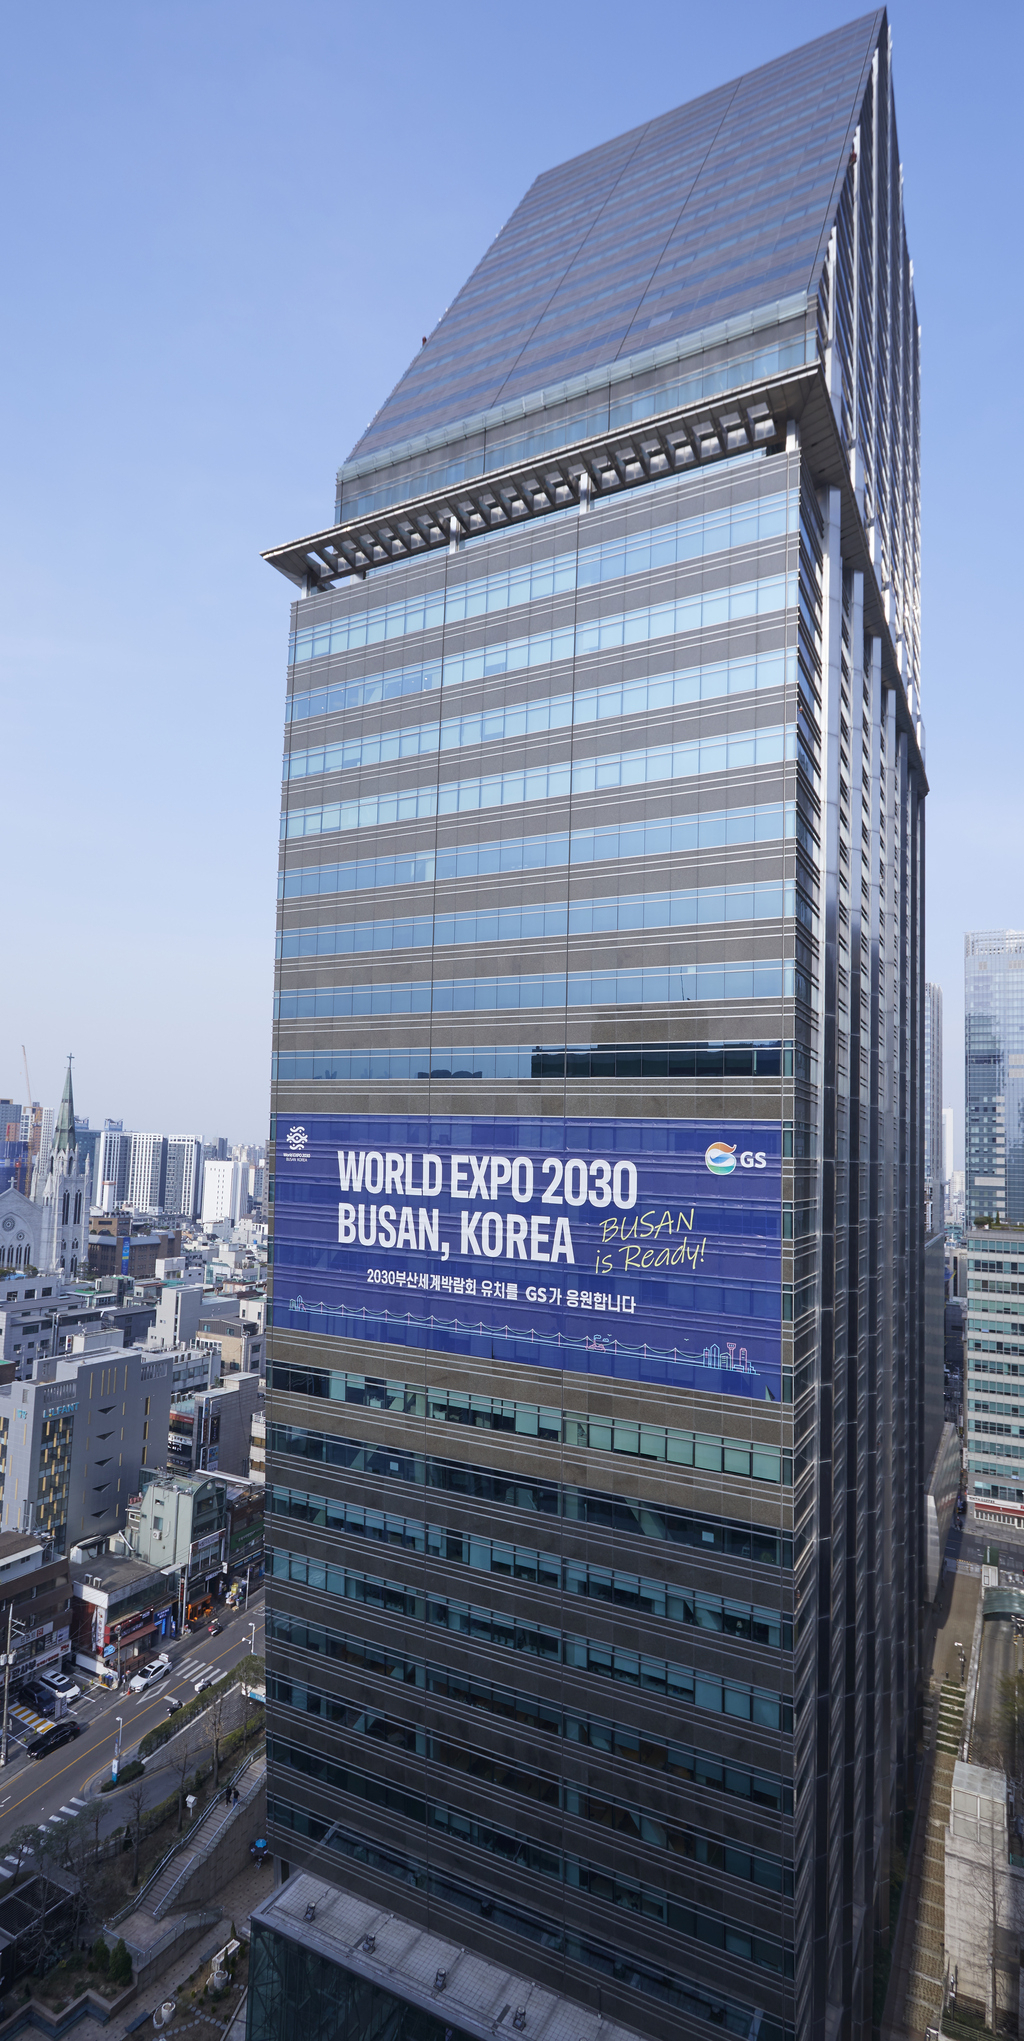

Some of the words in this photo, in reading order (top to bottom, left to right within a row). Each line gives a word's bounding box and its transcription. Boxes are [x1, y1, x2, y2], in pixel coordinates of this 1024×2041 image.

[337, 1151, 442, 1196] WORLD
[451, 1154, 533, 1203] EXPO
[541, 1157, 637, 1209] 2030
[740, 1151, 767, 1168] GS
[338, 1203, 449, 1261] BUSAN,
[461, 1210, 575, 1264] KOREA
[599, 1208, 694, 1243] BUSAN
[595, 1250, 613, 1274] is
[618, 1237, 707, 1271] Ready!
[366, 1269, 477, 1296] 2030부산세계박람회
[481, 1280, 518, 1301] 유치를
[525, 1286, 562, 1306] GS가
[566, 1289, 637, 1314] 응원합니다
